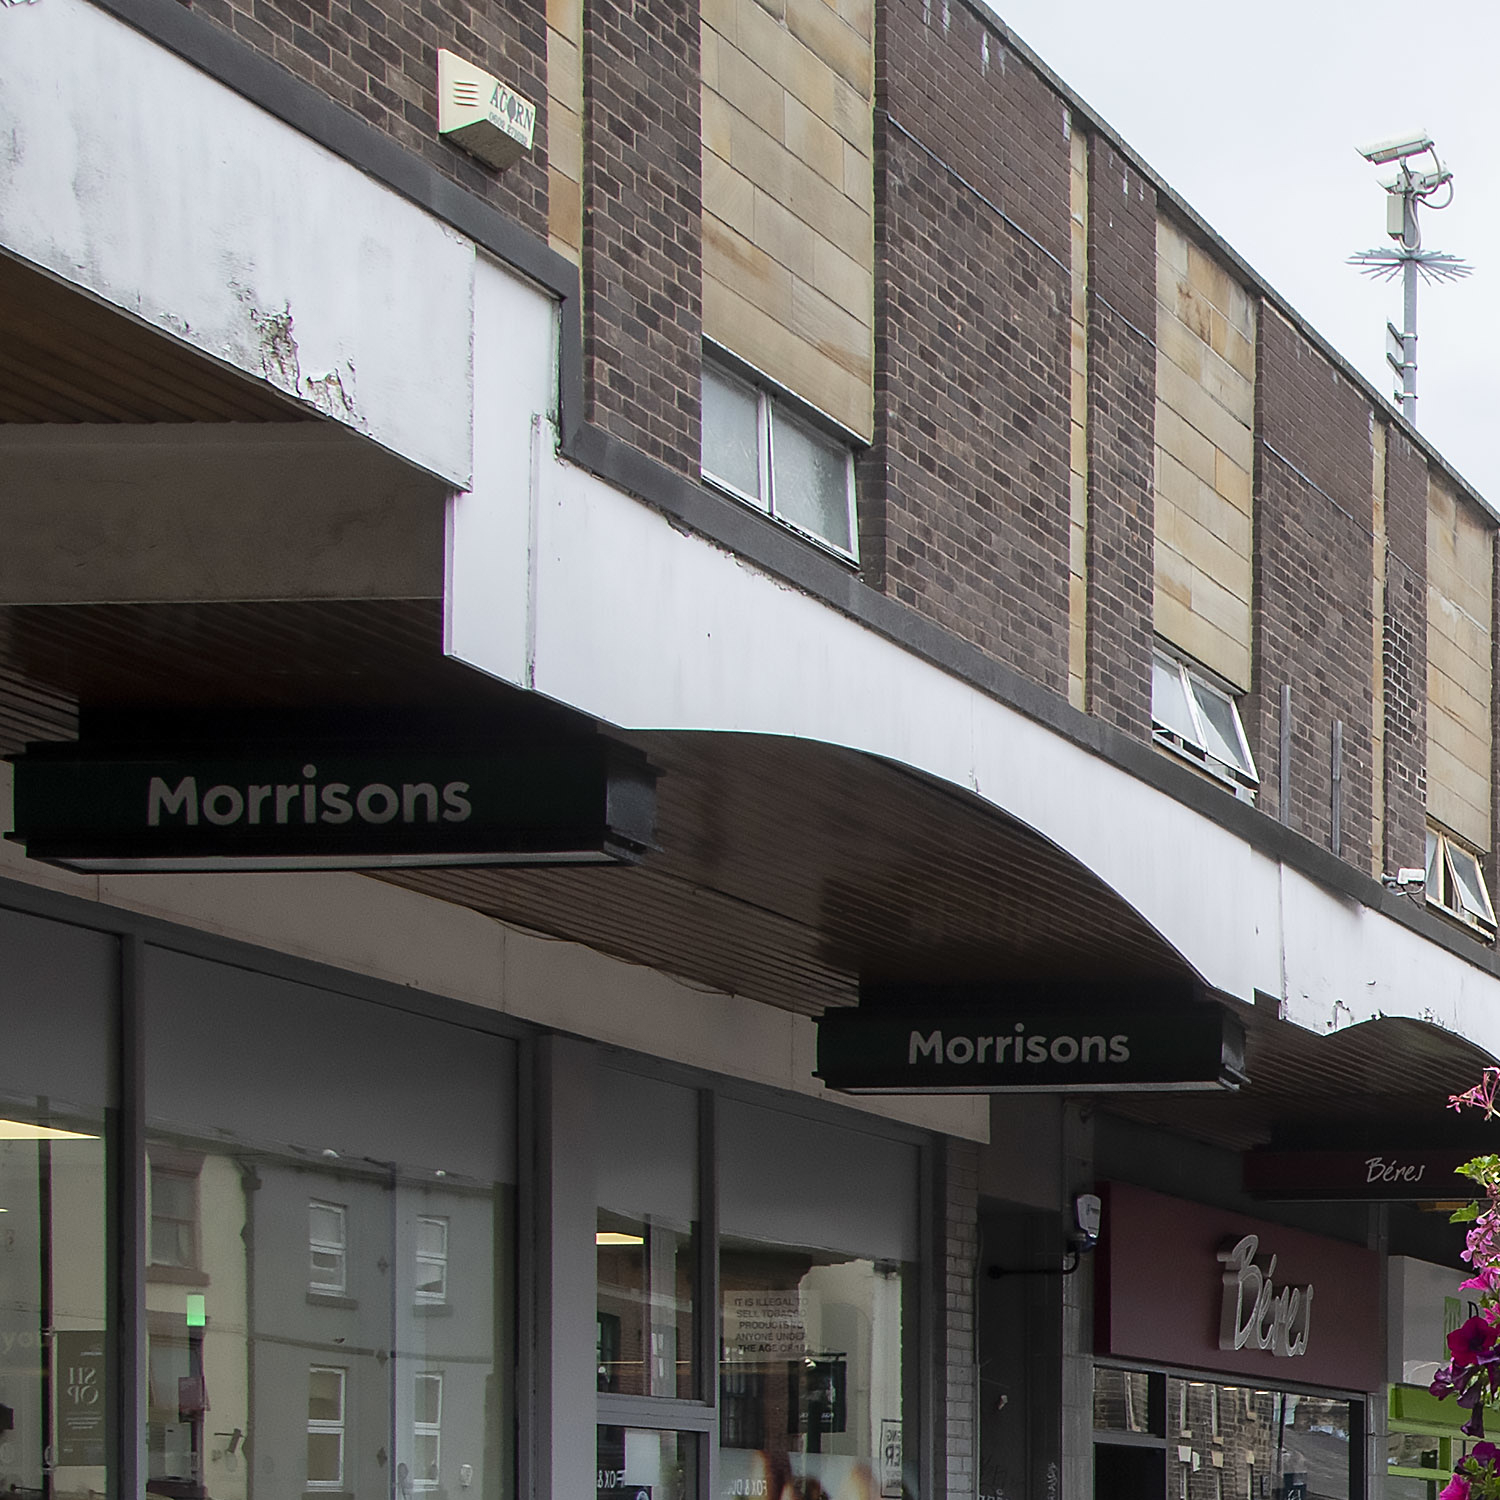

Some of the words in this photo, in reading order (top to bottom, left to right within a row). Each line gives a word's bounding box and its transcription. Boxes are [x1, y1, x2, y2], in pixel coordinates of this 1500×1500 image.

[147, 764, 473, 826] Morrisons
[908, 1022, 1131, 1064] Morrisons
[1365, 1157, 1426, 1183] Béres
[1219, 1234, 1314, 1357] Béres
